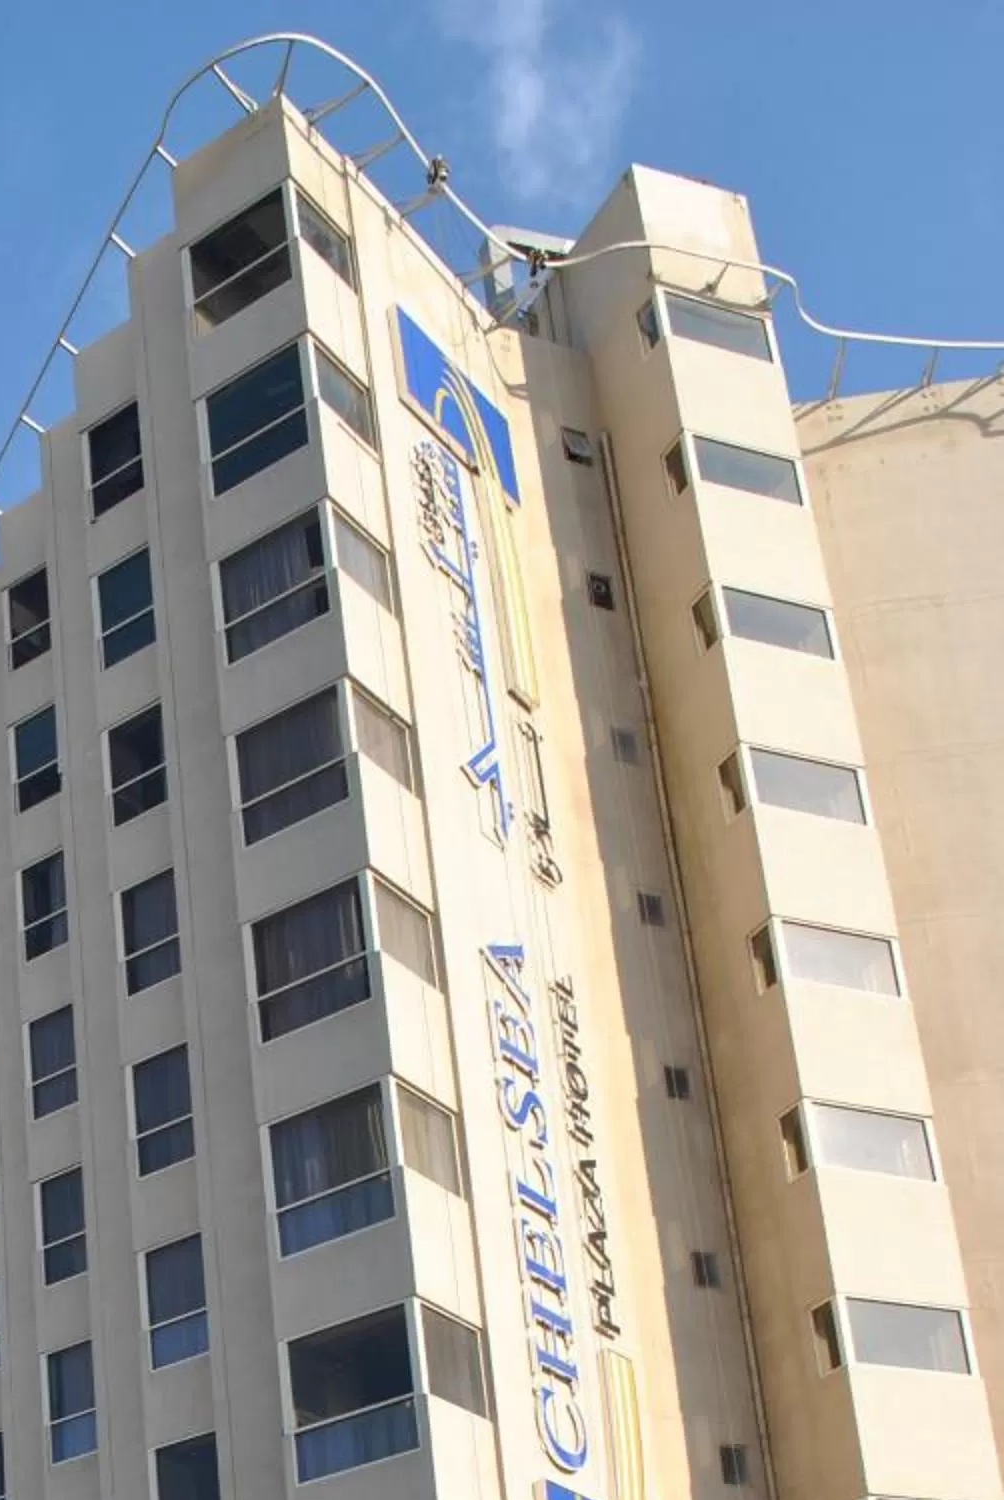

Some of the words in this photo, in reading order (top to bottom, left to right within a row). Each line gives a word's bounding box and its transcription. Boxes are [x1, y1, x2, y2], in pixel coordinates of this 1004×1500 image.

[552, 974, 595, 1148] HOTEL
[480, 943, 588, 1473] CHELSEA
[574, 1159, 621, 1341] PLAZA
